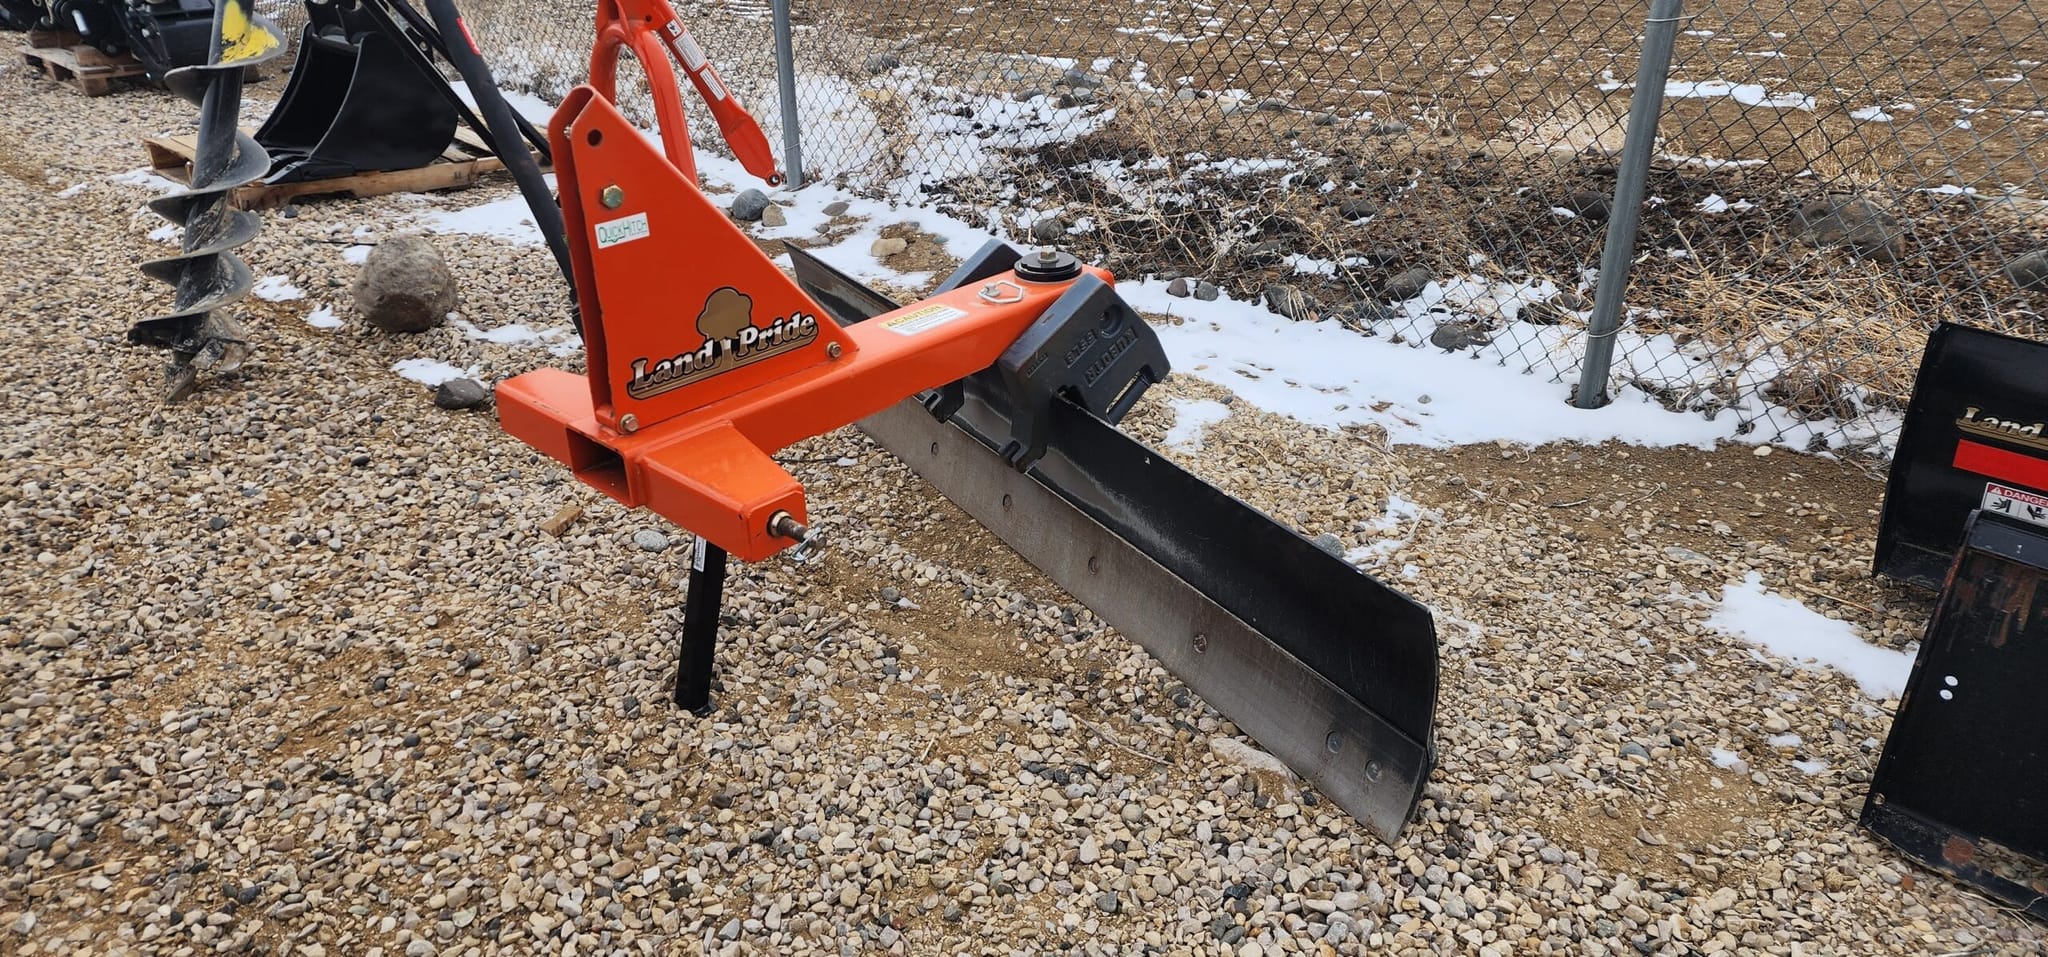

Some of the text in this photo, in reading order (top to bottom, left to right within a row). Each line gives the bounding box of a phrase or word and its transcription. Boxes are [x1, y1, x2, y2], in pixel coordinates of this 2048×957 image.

[633, 312, 815, 390] Land Pride
[1960, 406, 2045, 441] Land
[2003, 489, 2048, 507] DANGE
